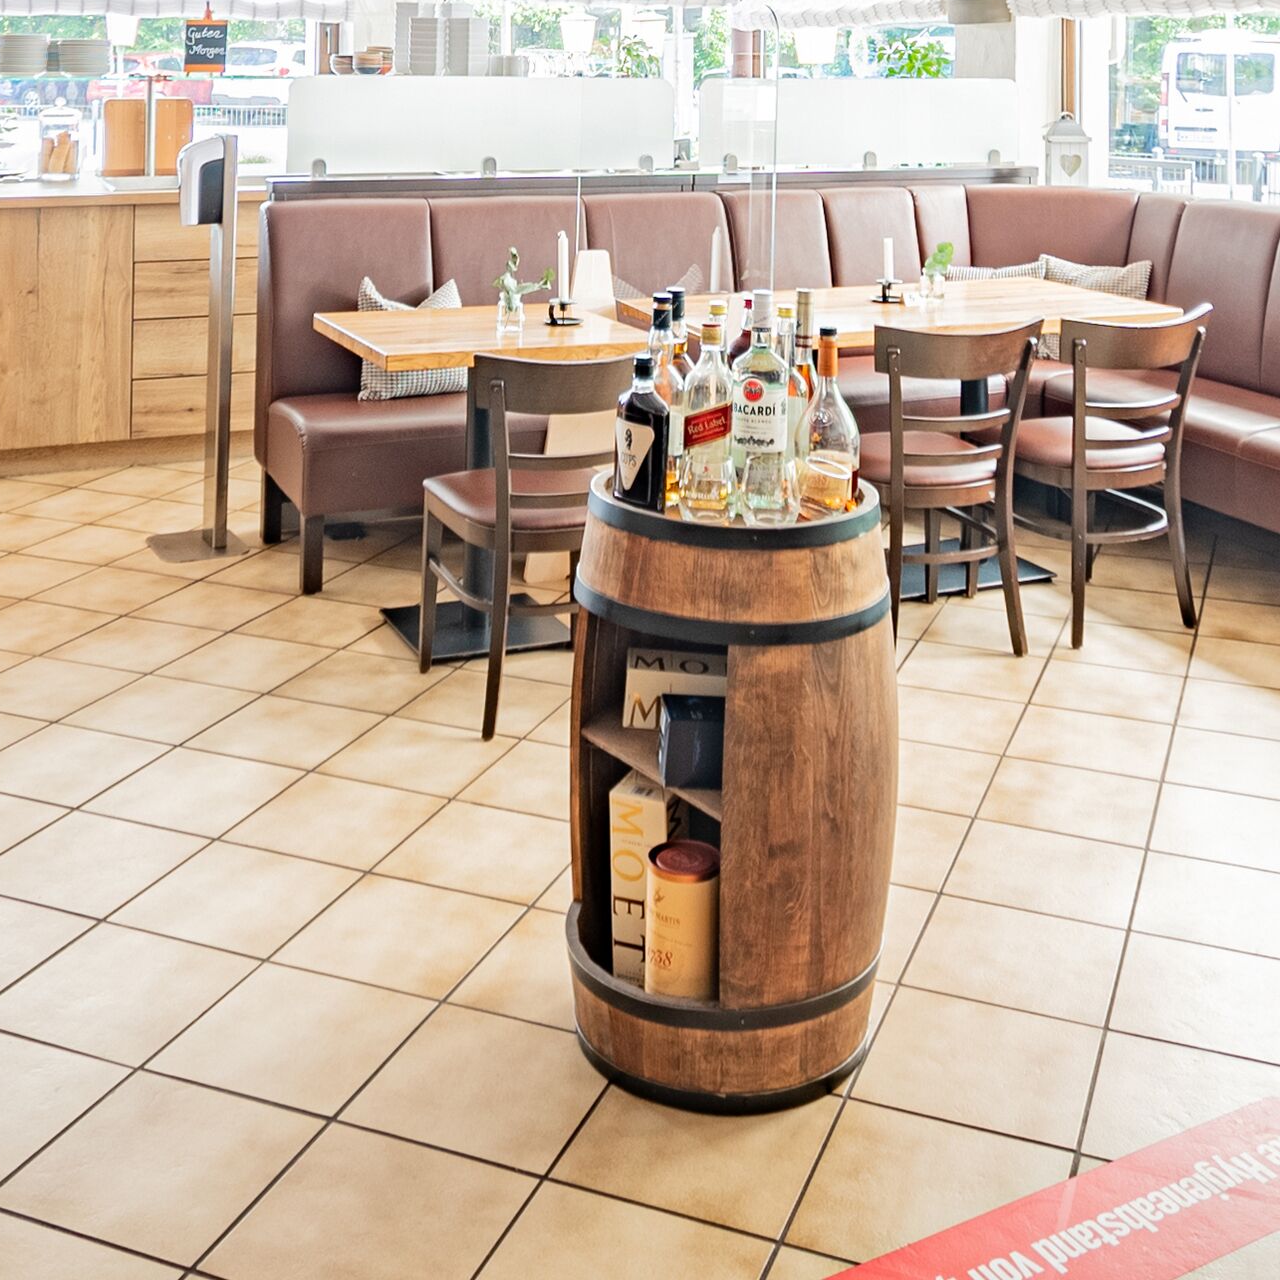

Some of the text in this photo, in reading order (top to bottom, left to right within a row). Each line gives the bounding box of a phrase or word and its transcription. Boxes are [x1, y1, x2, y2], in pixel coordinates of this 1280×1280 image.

[186, 27, 224, 45] Guten
[734, 402, 776, 417] BACARDÍ
[687, 423, 704, 436] Red
[704, 415, 727, 430] Label
[634, 654, 727, 676] MO
[1031, 1153, 1277, 1275] Hygieneabstand
